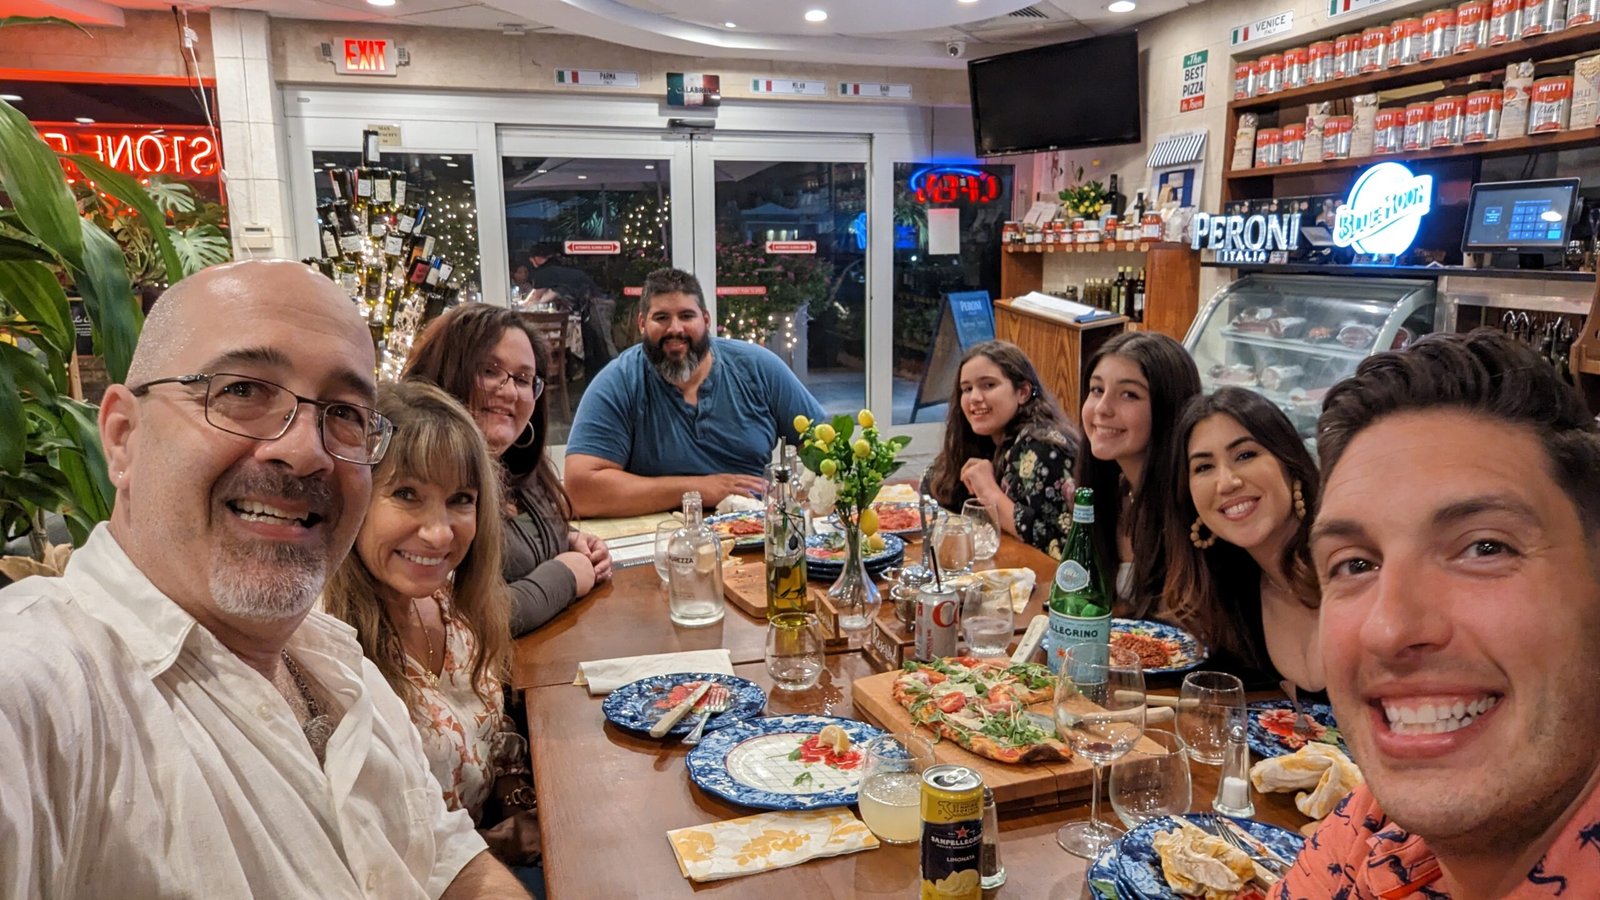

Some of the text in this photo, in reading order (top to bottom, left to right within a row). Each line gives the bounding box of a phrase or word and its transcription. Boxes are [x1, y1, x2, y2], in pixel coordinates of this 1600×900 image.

[1458, 7, 1481, 17] MUTTI
[1255, 15, 1286, 33] VENICE
[345, 39, 386, 71] EXIT
[1187, 54, 1203, 65] The
[600, 72, 617, 80] PARMA
[1184, 65, 1205, 82] BEST
[1182, 81, 1204, 98] PIZZA
[1538, 82, 1567, 93] MUTTI
[1468, 96, 1490, 106] MUTTI
[1434, 102, 1454, 112] MUTTI
[1190, 212, 1301, 251] PERONI
[1223, 250, 1267, 262] ITALIA
[946, 854, 975, 863] LIMONATA
